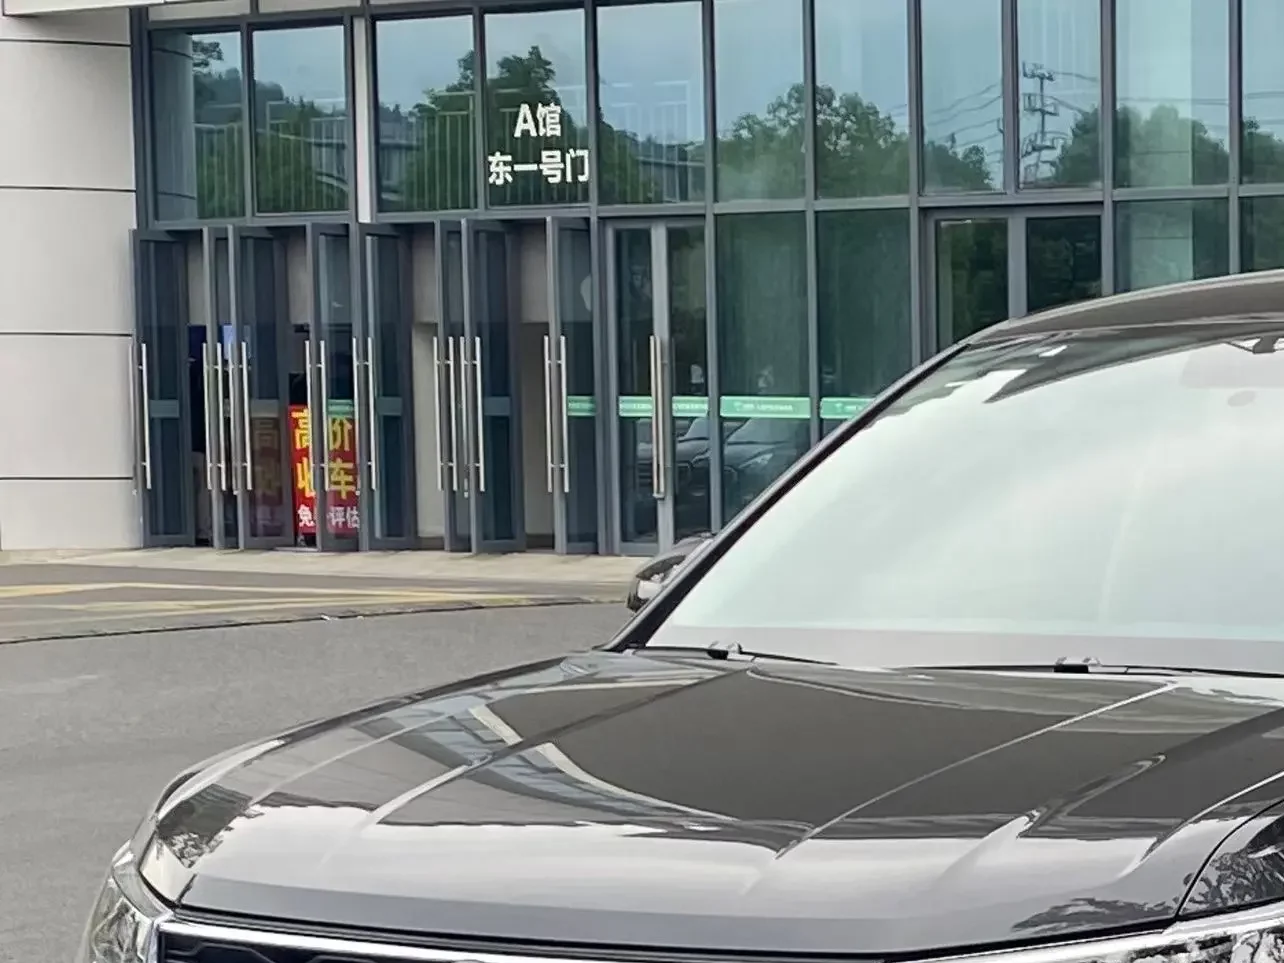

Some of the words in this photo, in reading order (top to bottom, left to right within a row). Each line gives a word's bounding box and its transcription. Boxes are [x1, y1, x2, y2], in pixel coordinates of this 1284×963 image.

[514, 102, 562, 138] A馆
[487, 148, 590, 185] 东一号门
[298, 504, 360, 529] 免评估
